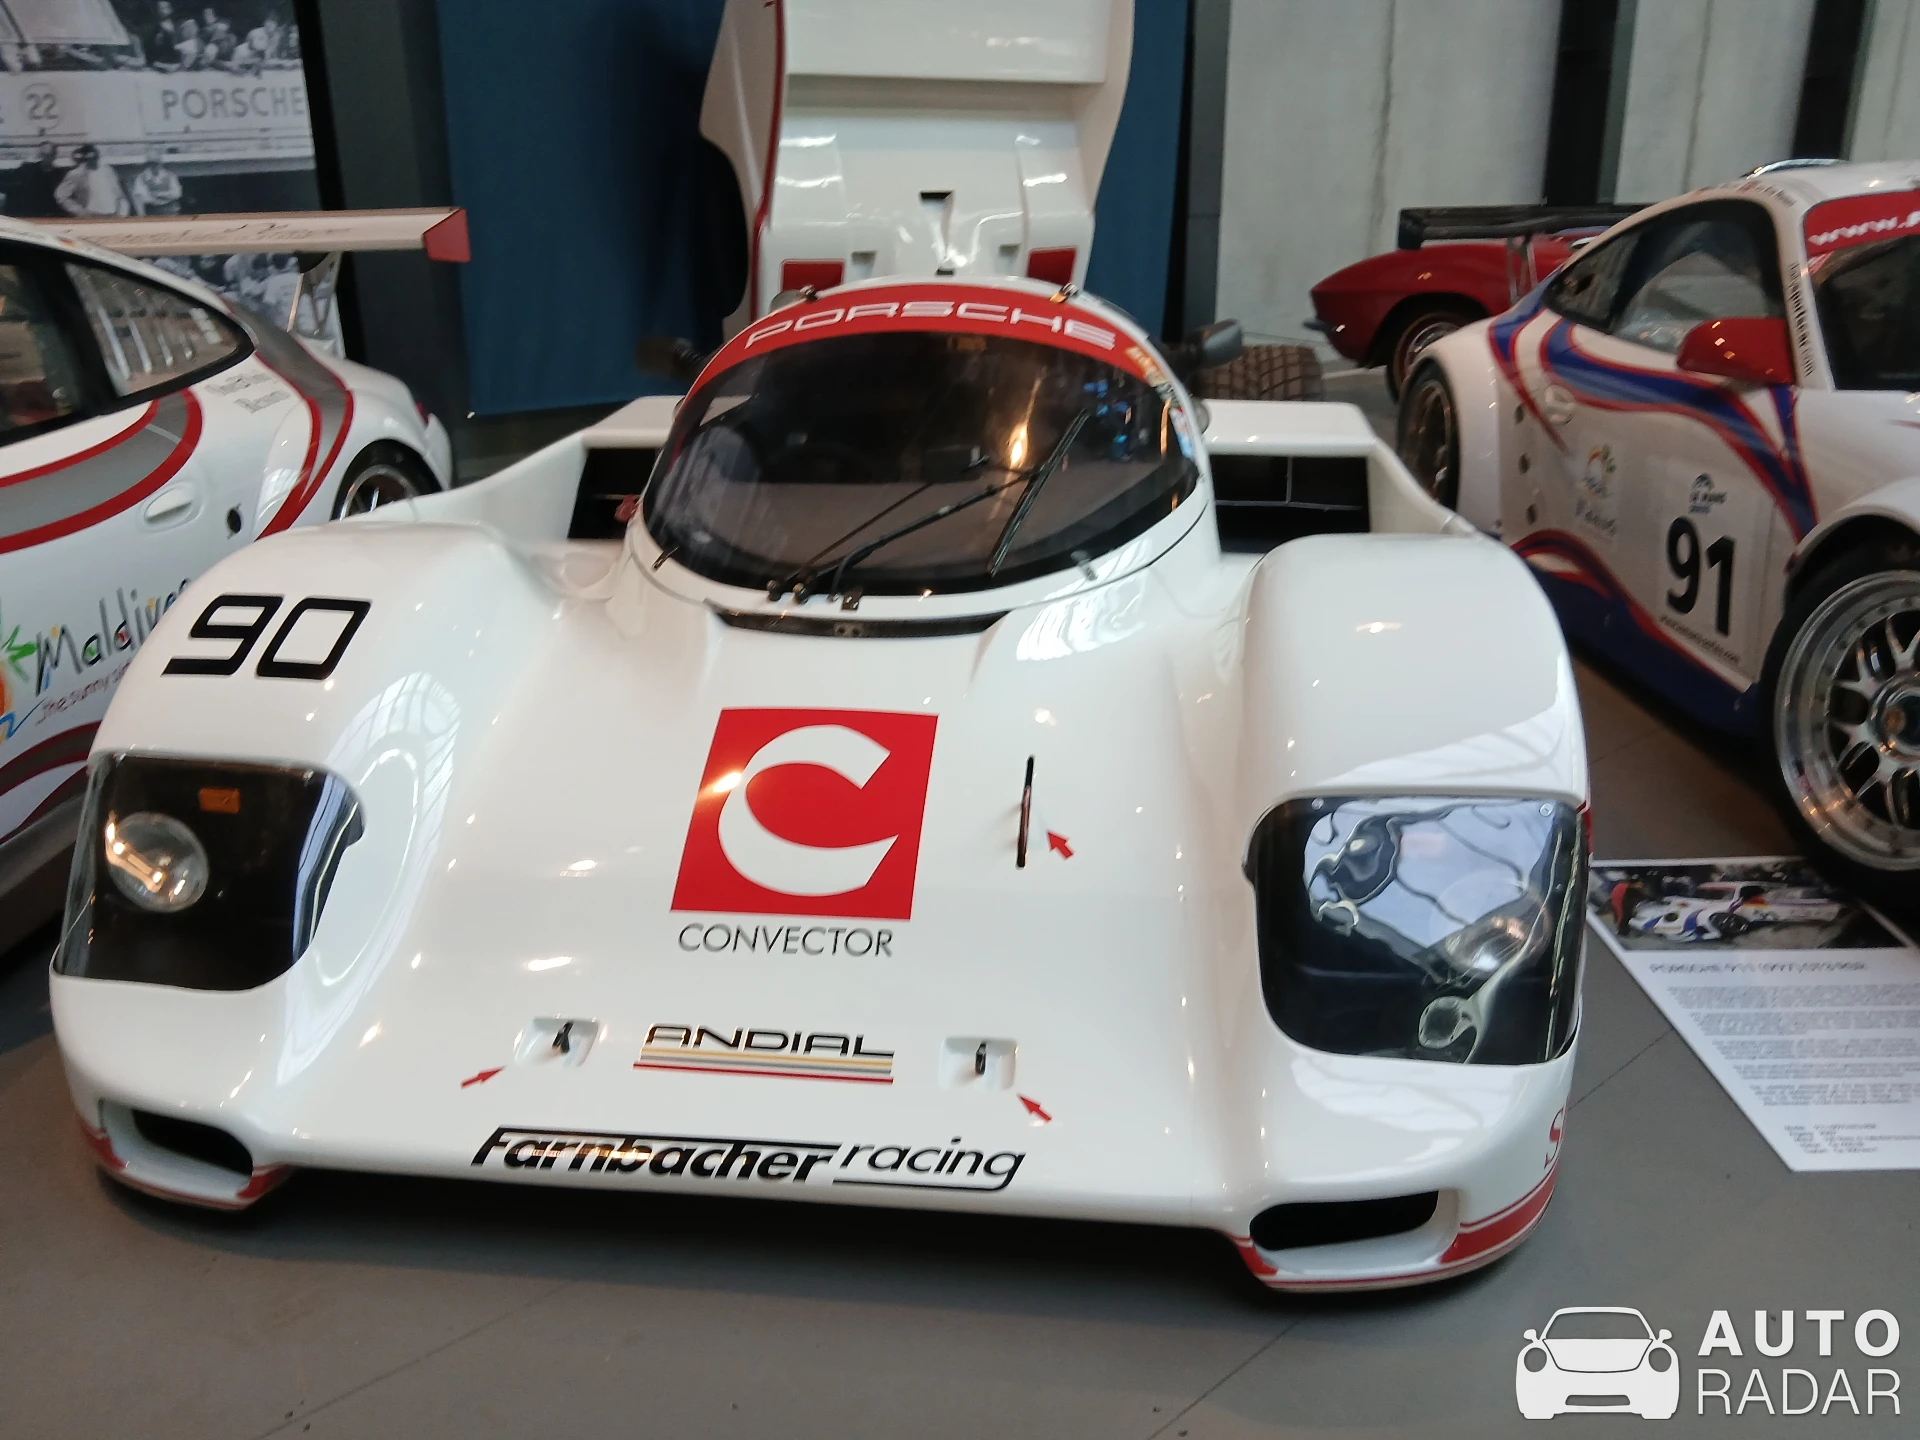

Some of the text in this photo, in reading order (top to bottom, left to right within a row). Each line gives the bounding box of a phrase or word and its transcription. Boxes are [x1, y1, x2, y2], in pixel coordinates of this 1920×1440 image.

[26, 93, 58, 120] 22
[161, 86, 305, 120] PORSCHE
[744, 301, 1116, 352] PORSCHE
[1667, 516, 1735, 638] 91
[160, 593, 373, 681] 90
[717, 723, 900, 897] C
[678, 922, 894, 958] CONVECTOR
[645, 1023, 895, 1057] ANDIAL
[470, 1125, 1026, 1192] Farnbacher racing
